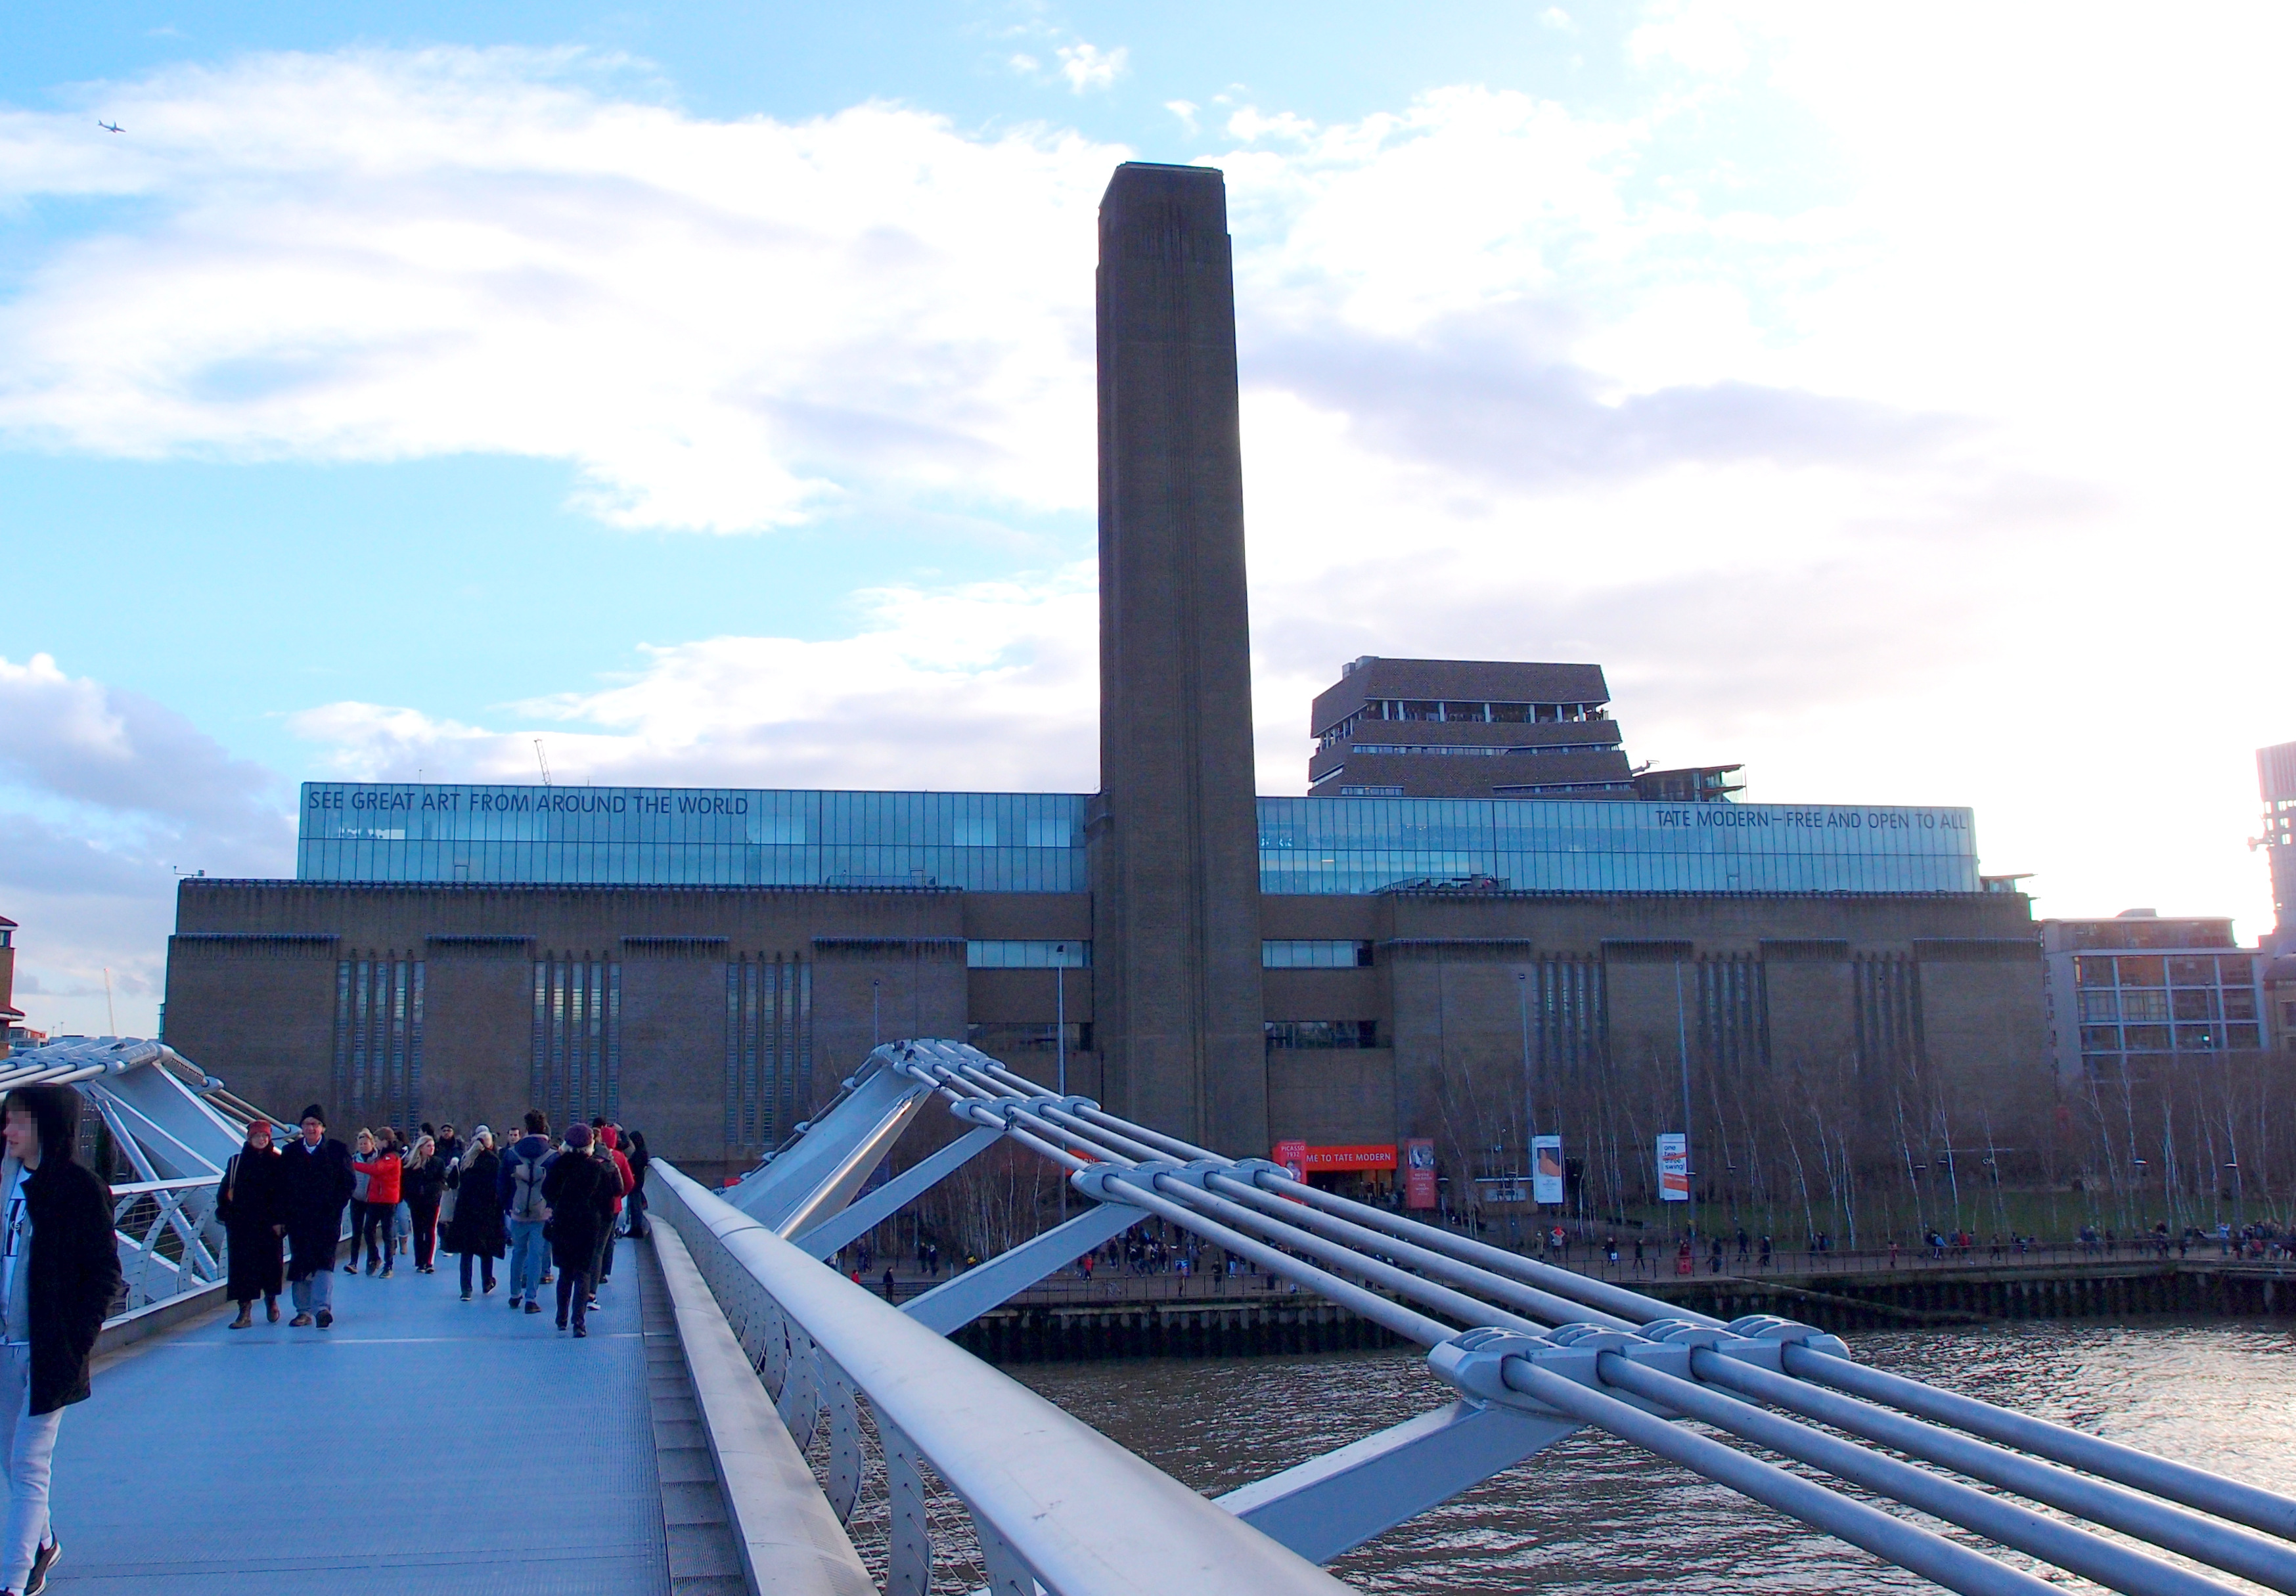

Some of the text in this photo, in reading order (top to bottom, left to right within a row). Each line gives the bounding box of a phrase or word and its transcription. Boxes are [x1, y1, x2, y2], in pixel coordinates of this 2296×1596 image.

[308, 790, 749, 815] SEE GREAT ART FROM AROUND THE WORLD
[1655, 810, 1690, 827] TATE
[1697, 810, 1768, 828] MODERN
[1786, 812, 1822, 828] FREE
[1827, 812, 1862, 828] AND
[1868, 812, 1910, 829] OPEN
[1916, 813, 1935, 829] TO
[1940, 814, 1967, 830] ALL
[1334, 1153, 1353, 1162] TATE
[1355, 1153, 1391, 1161] MODERN
